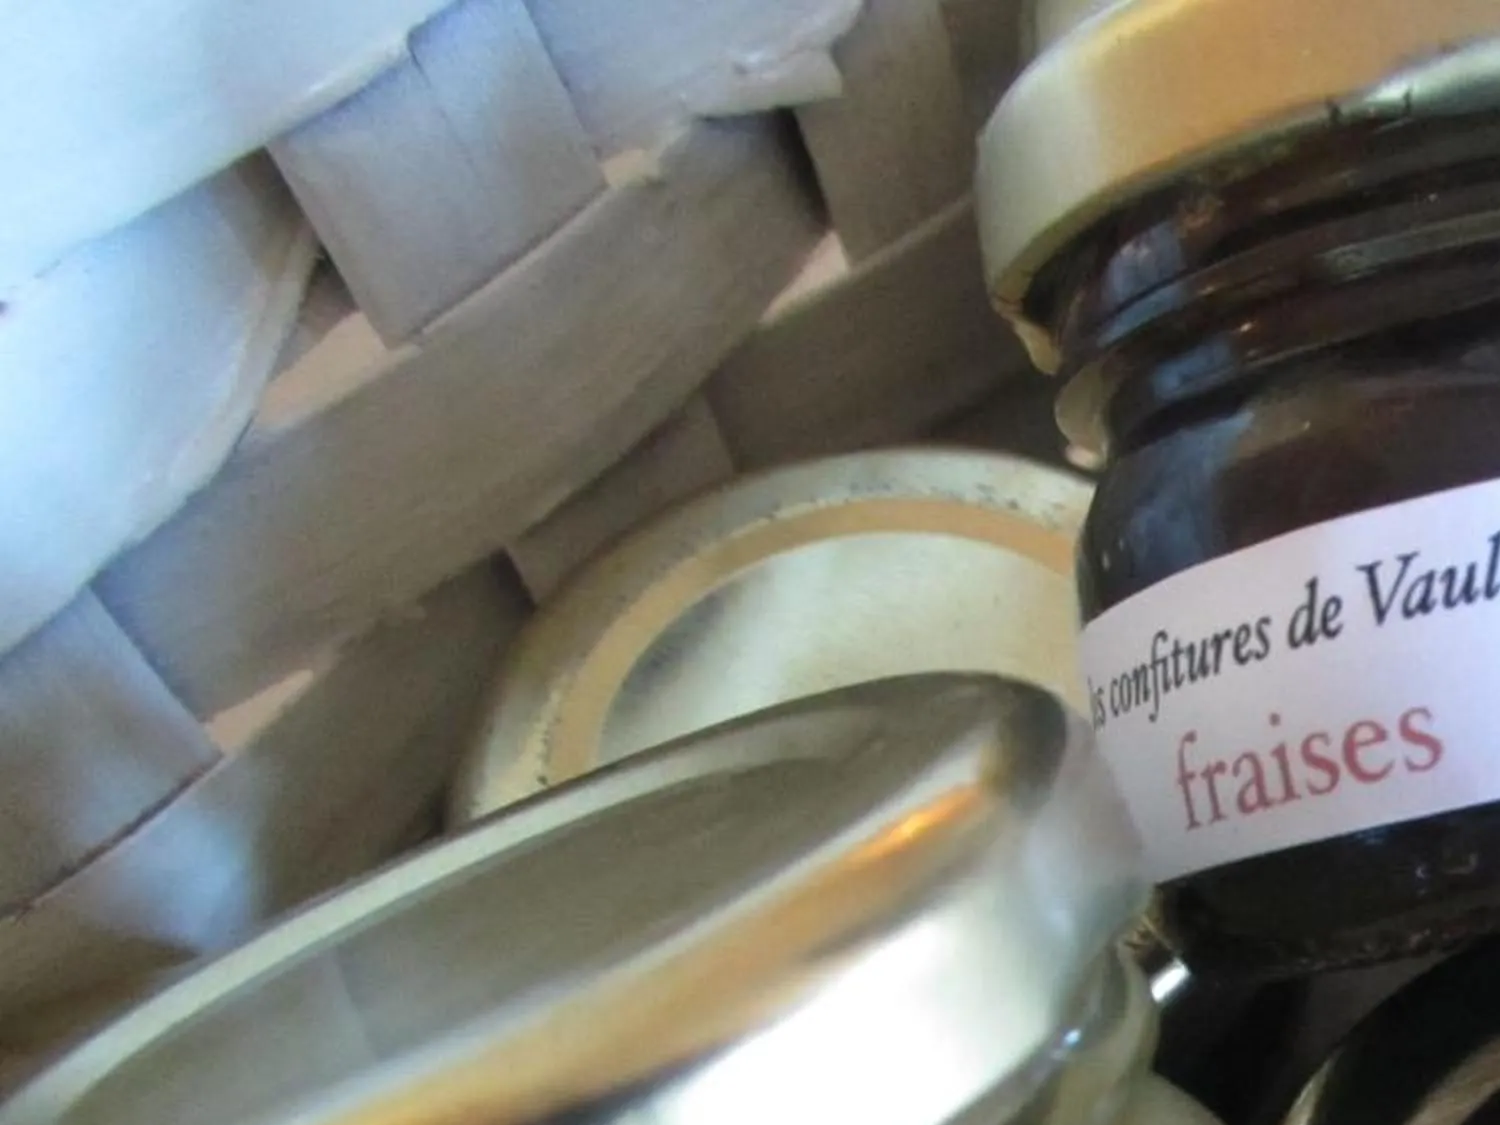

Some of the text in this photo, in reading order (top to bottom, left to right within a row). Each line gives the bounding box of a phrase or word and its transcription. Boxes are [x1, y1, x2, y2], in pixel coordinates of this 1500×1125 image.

[1109, 613, 1273, 724] confitures
[1287, 575, 1344, 650] de
[1175, 704, 1445, 831] fraises
